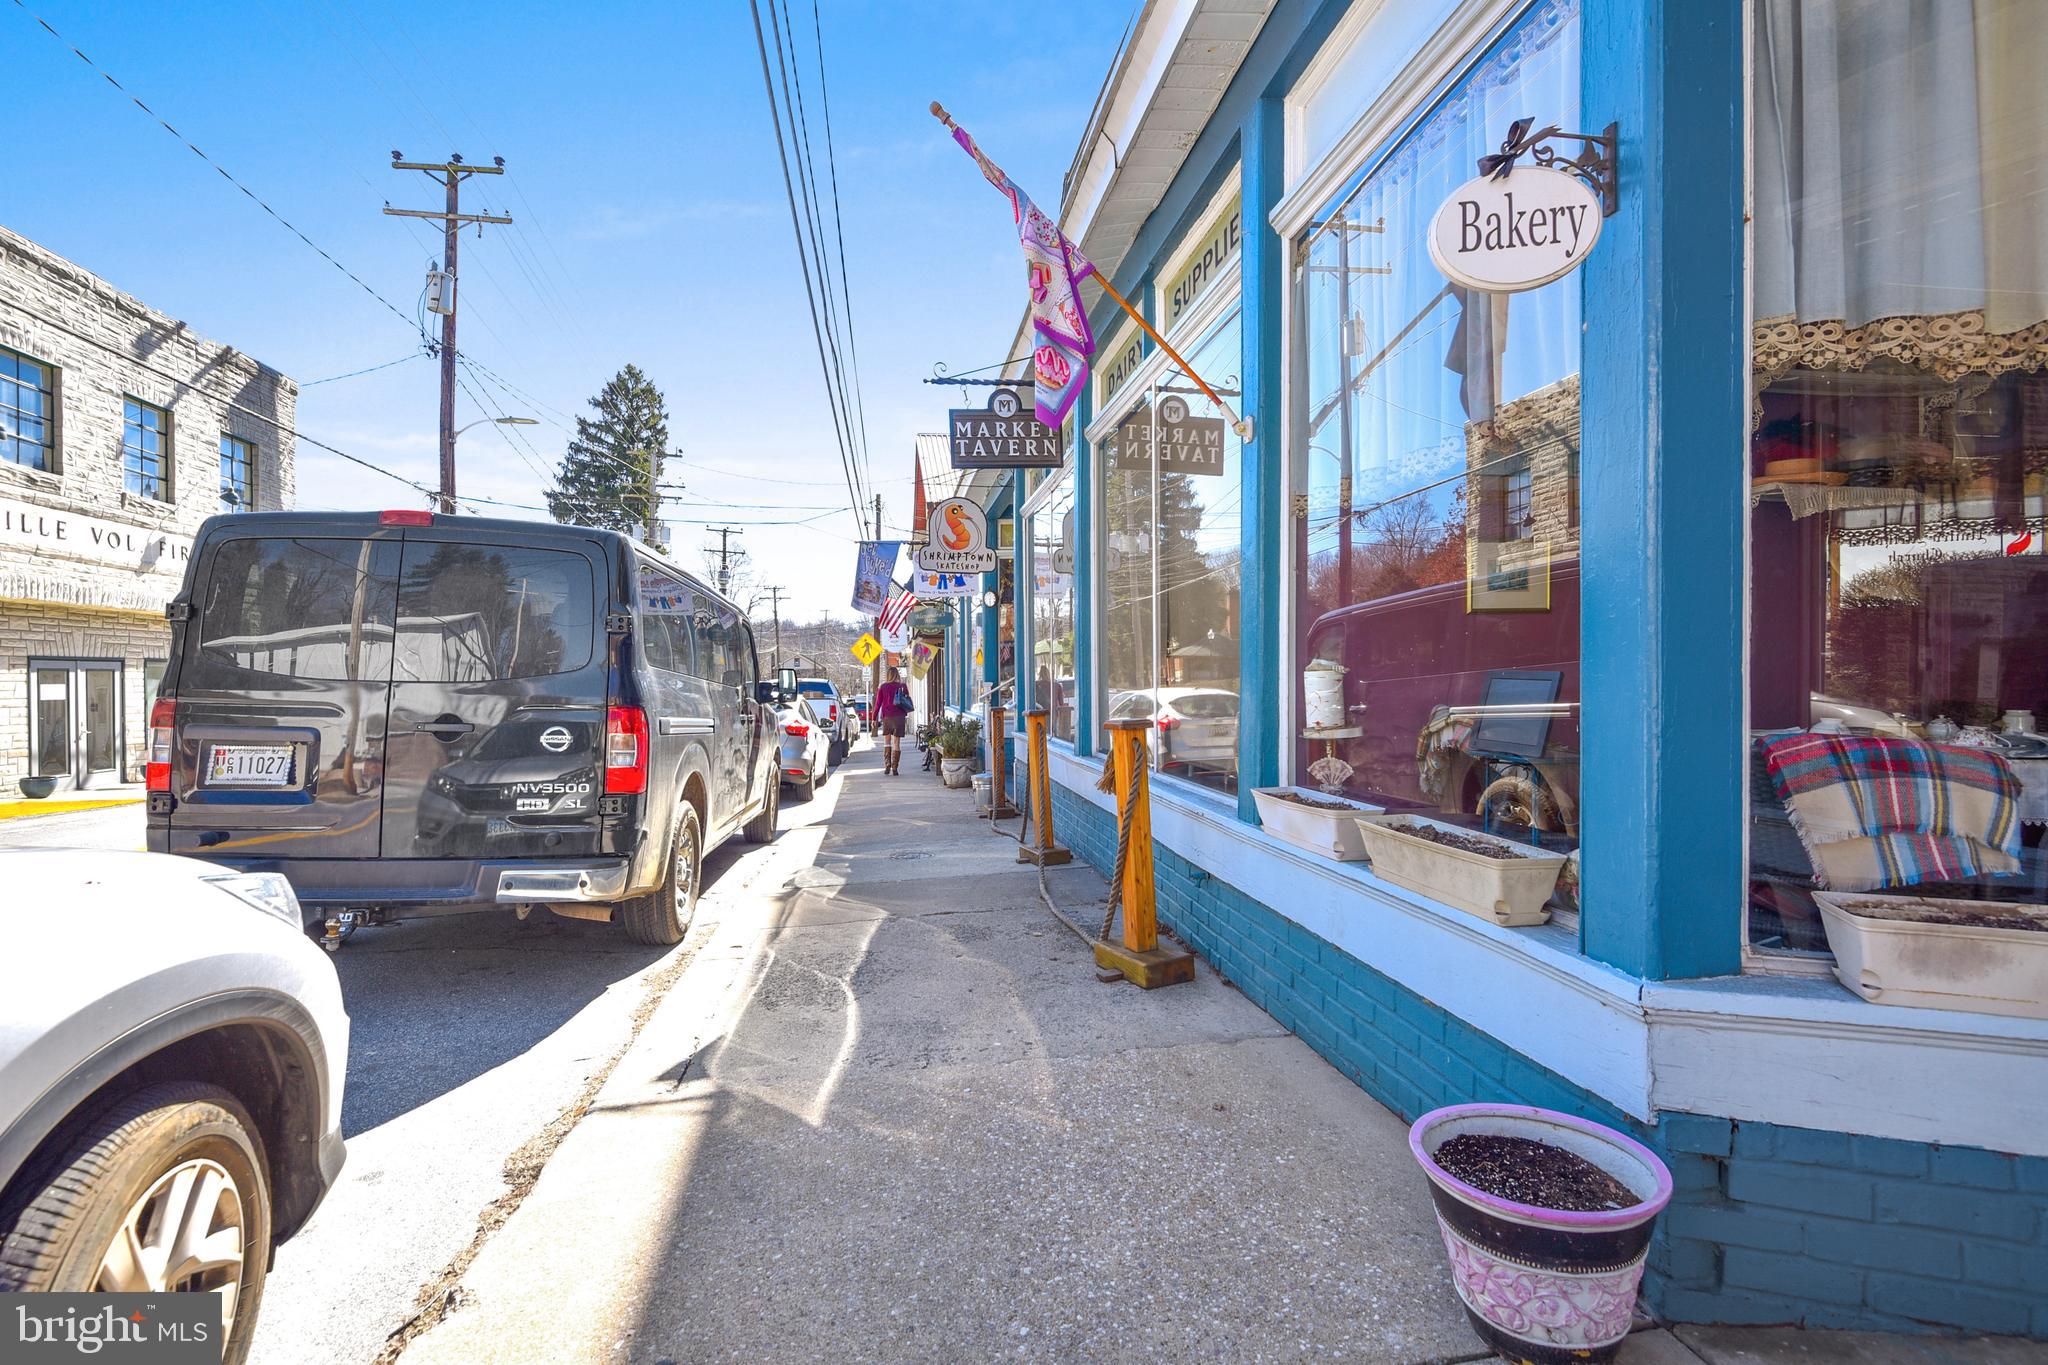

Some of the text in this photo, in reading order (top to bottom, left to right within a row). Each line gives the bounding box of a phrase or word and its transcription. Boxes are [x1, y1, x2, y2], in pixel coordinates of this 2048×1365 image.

[1458, 192, 1588, 258] Bakery
[1173, 212, 1240, 317] SUPPLIE
[1108, 338, 1142, 395] DAIRY
[955, 439, 1057, 457] TAVERN
[6, 510, 67, 541] ILLE
[159, 540, 189, 561] FIR
[923, 550, 993, 562] SHRIMPTOWN
[936, 562, 980, 570] SKATESHOP
[238, 756, 285, 775] 11027
[516, 783, 590, 793] NV3500
[564, 799, 587, 809] SL
